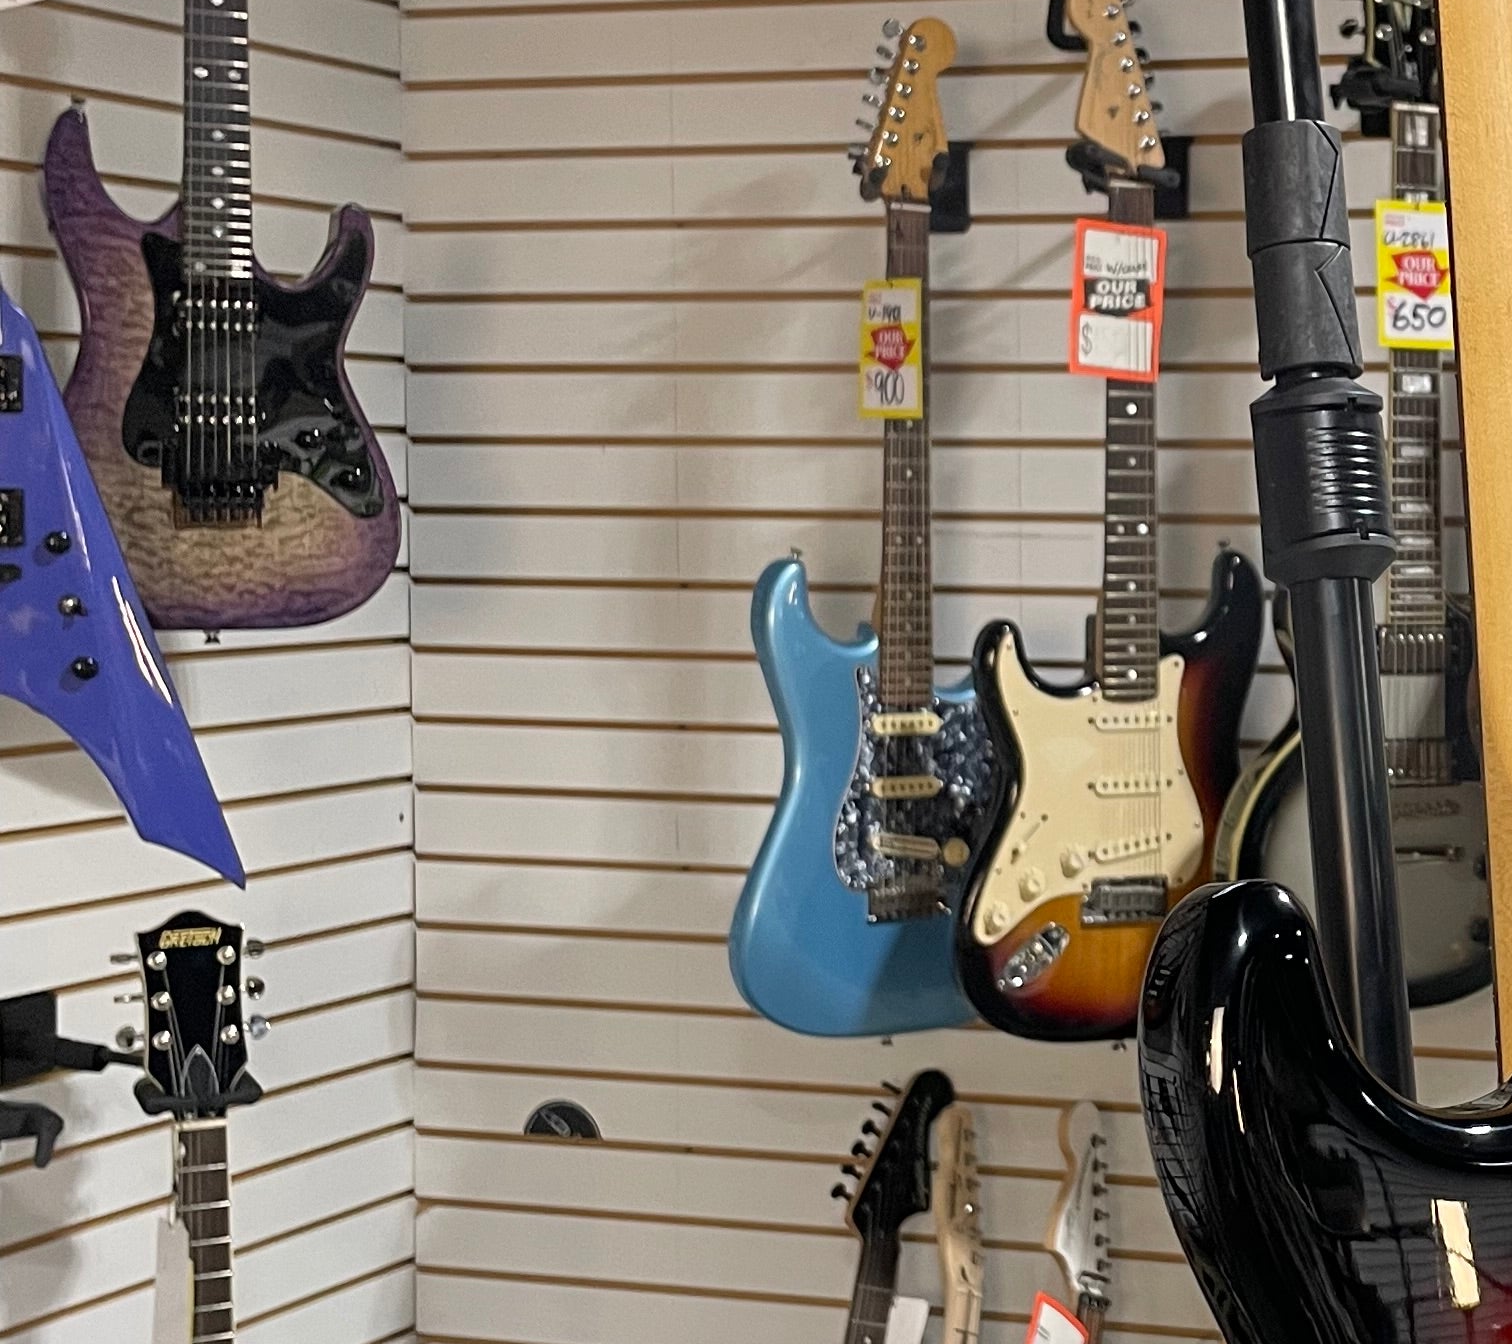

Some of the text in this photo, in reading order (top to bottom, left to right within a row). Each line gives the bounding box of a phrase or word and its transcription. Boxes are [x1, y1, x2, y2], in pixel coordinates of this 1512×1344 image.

[1403, 256, 1435, 272] OUR
[1096, 279, 1138, 295] OUR
[1398, 271, 1439, 287] PRICE
[1089, 294, 1147, 310] PRICE
[879, 328, 904, 341] OUR
[874, 344, 905, 360] PRICE
[159, 927, 222, 950] GRETSCH
